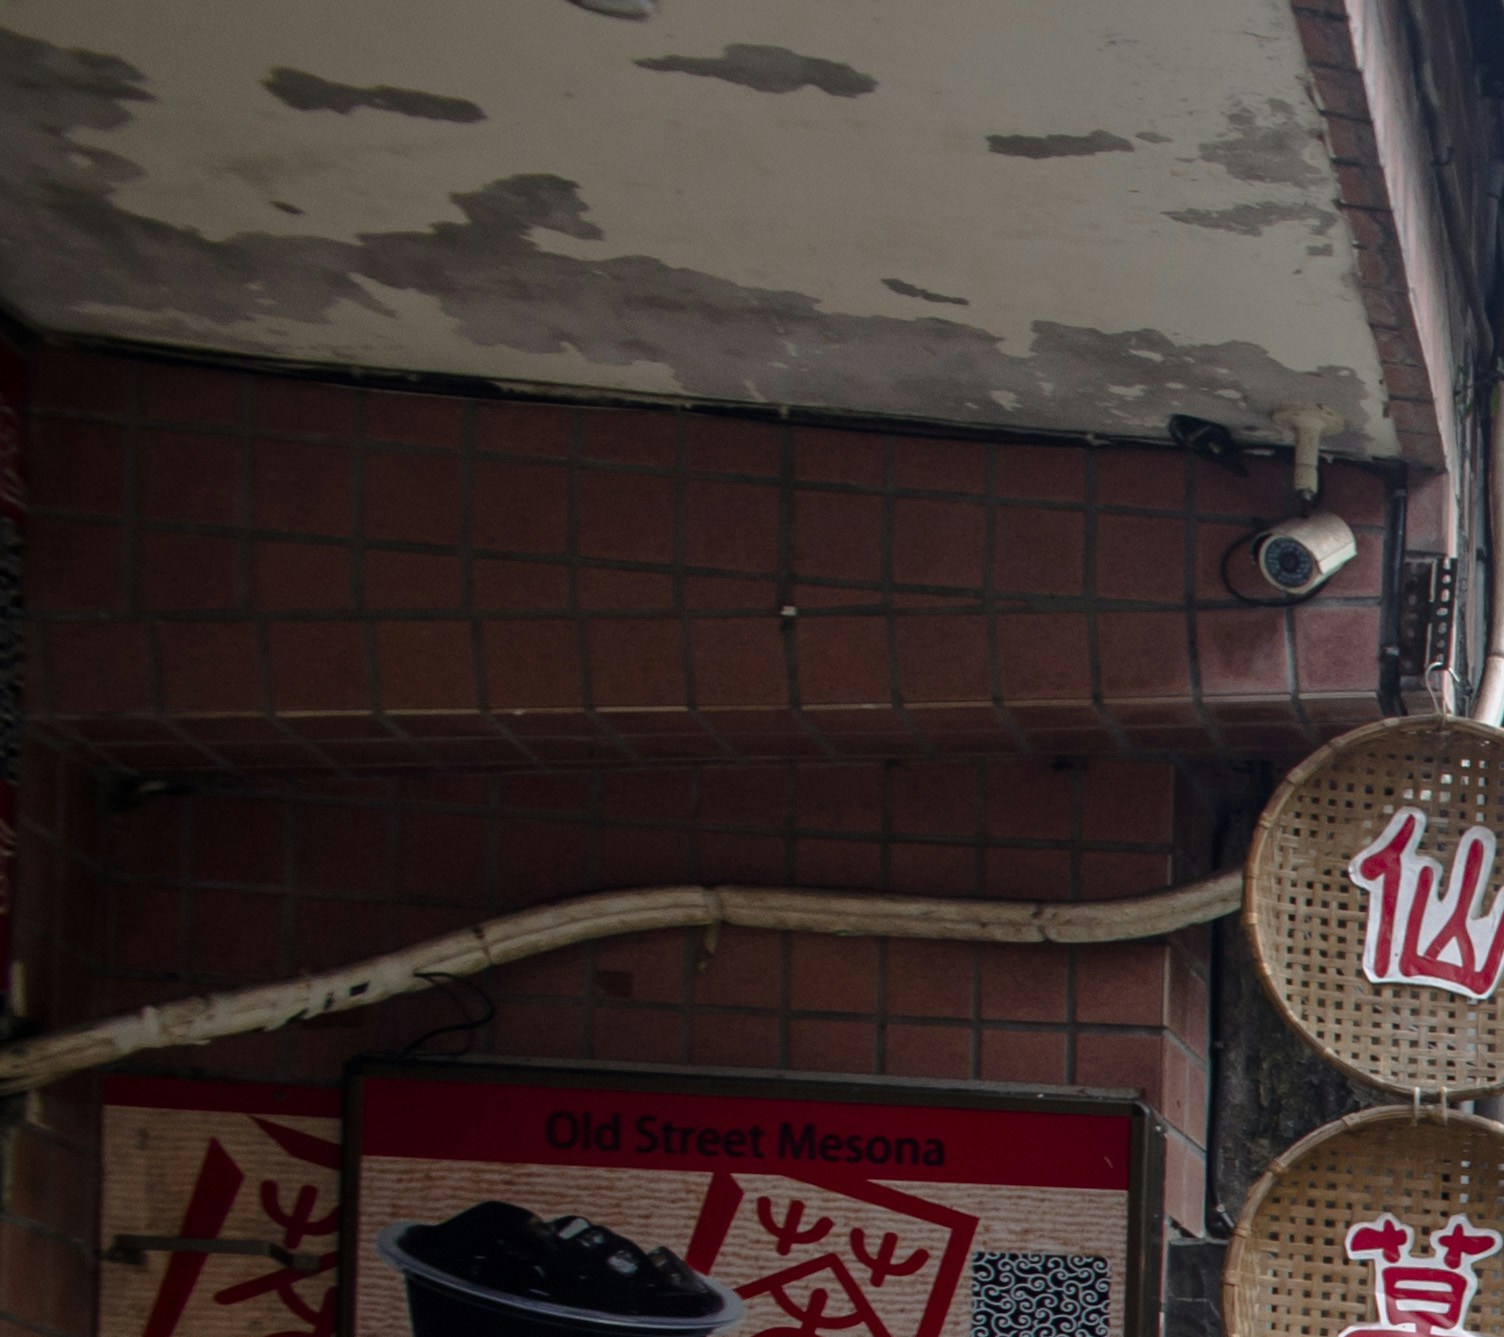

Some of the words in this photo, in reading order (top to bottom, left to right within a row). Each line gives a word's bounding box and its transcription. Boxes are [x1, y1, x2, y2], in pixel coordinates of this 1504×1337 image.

[545, 1109, 625, 1154] Old
[636, 1113, 765, 1160] Street
[777, 1120, 947, 1168] Mesona
